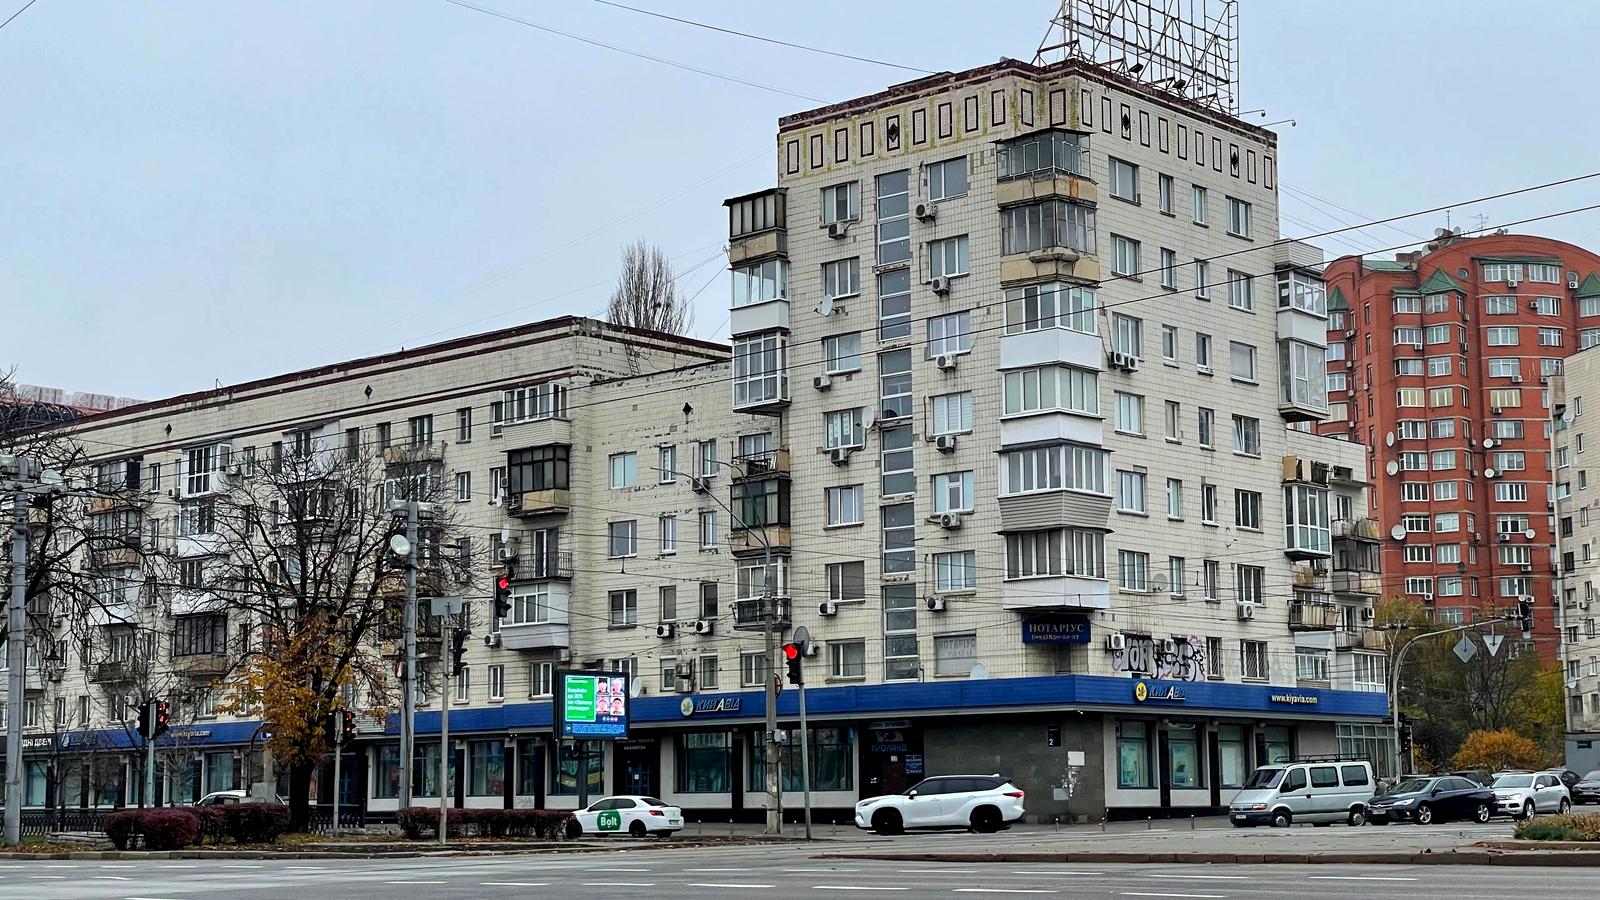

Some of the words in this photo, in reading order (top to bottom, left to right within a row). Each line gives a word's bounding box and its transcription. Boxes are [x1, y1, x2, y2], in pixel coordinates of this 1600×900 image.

[1029, 623, 1085, 633] НОТАРІУС
[1271, 694, 1318, 704] www.kiyavia.com
[600, 816, 618, 829] Bolt
